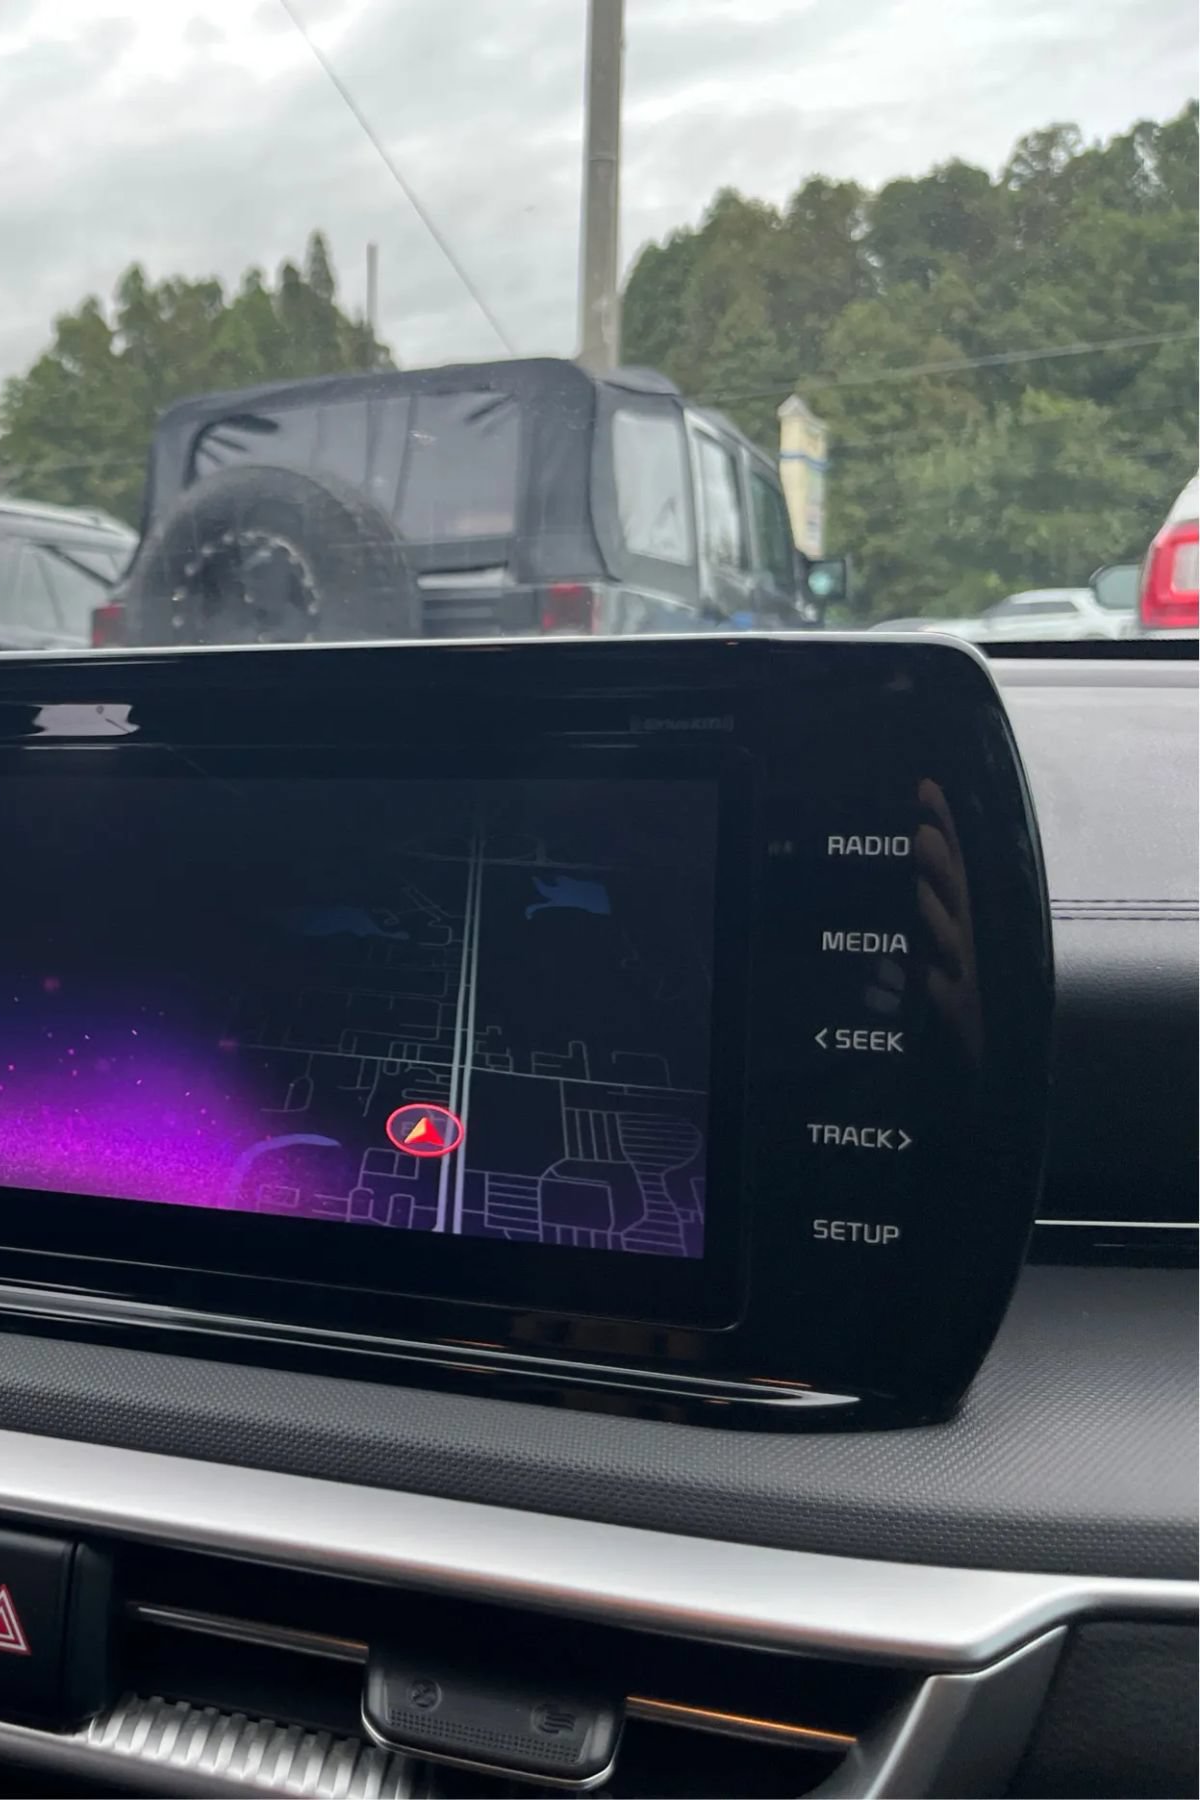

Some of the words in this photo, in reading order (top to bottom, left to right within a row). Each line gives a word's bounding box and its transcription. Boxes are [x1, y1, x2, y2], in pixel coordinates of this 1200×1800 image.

[827, 835, 910, 856] RADIO
[822, 931, 908, 954] MEDIA
[835, 1029, 904, 1052] SEEK
[807, 1123, 893, 1149] TRACK
[813, 1219, 900, 1245] SETUP
